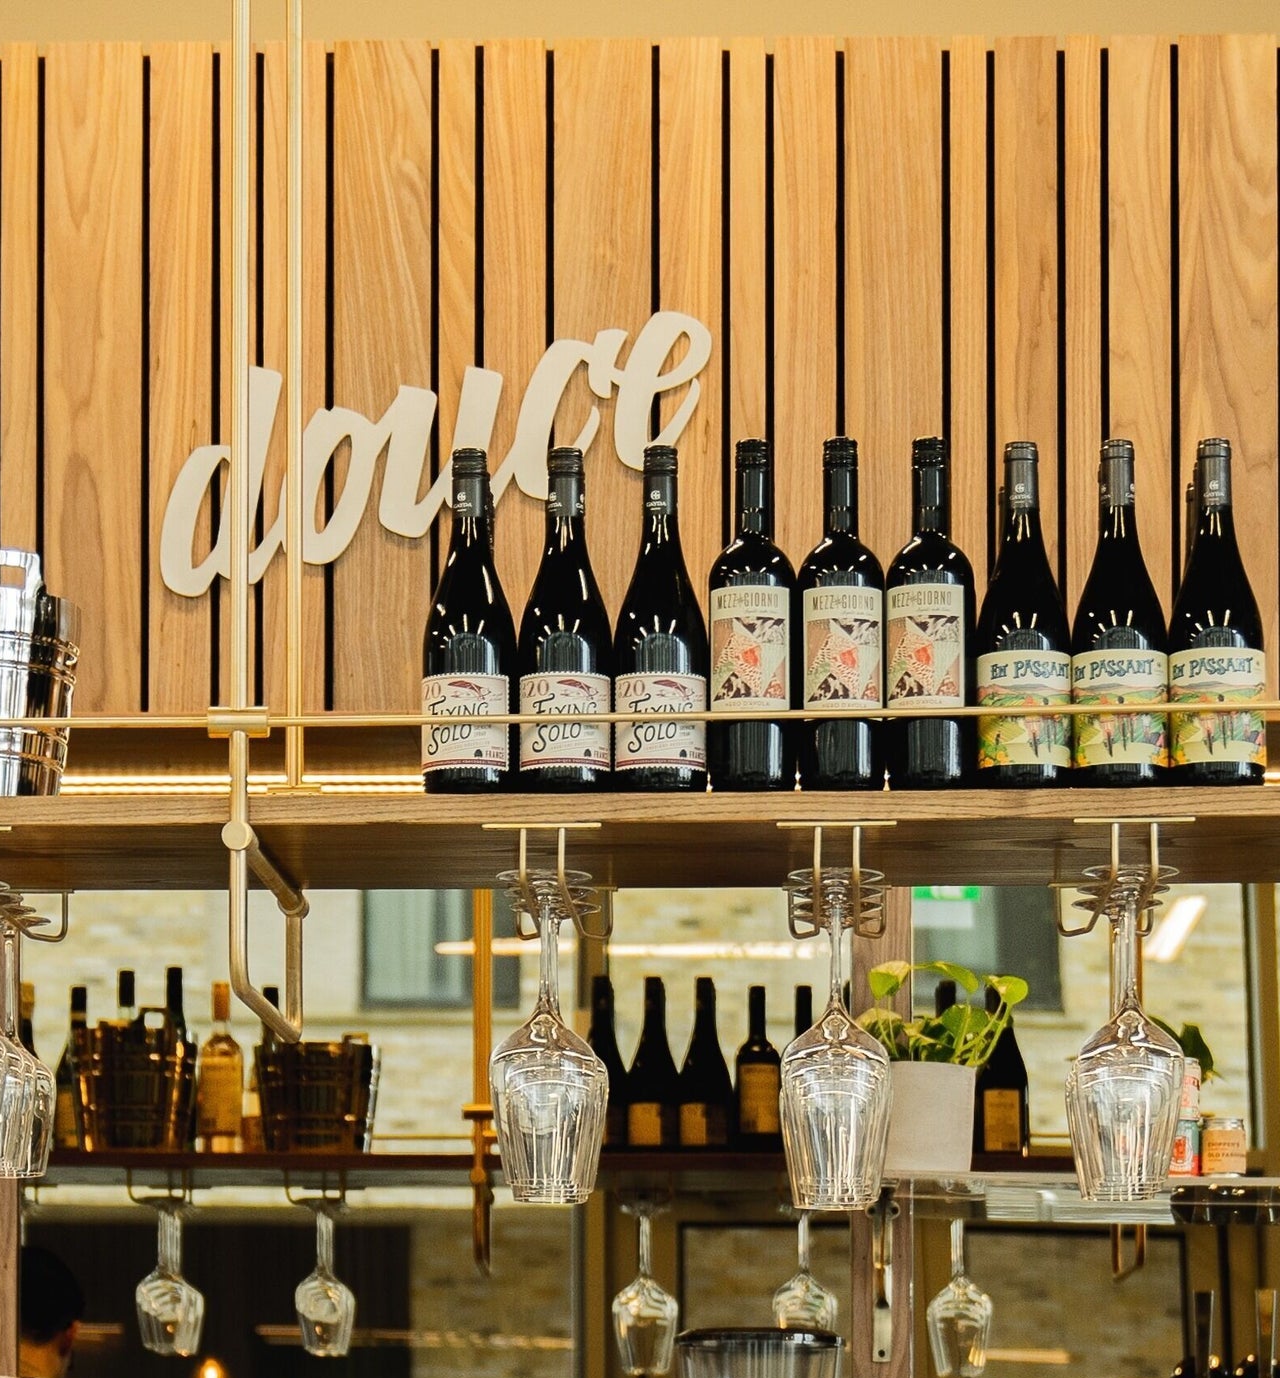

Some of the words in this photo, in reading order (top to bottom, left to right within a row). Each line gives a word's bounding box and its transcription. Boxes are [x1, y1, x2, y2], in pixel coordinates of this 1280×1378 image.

[160, 311, 712, 597] douce
[1013, 659, 1069, 679] PASSANT
[1089, 658, 1154, 680] PASSANT
[1189, 657, 1253, 678] PASSANT
[427, 723, 472, 755] SOLO
[532, 722, 582, 753] SOLO
[628, 721, 677, 753] SOLO
